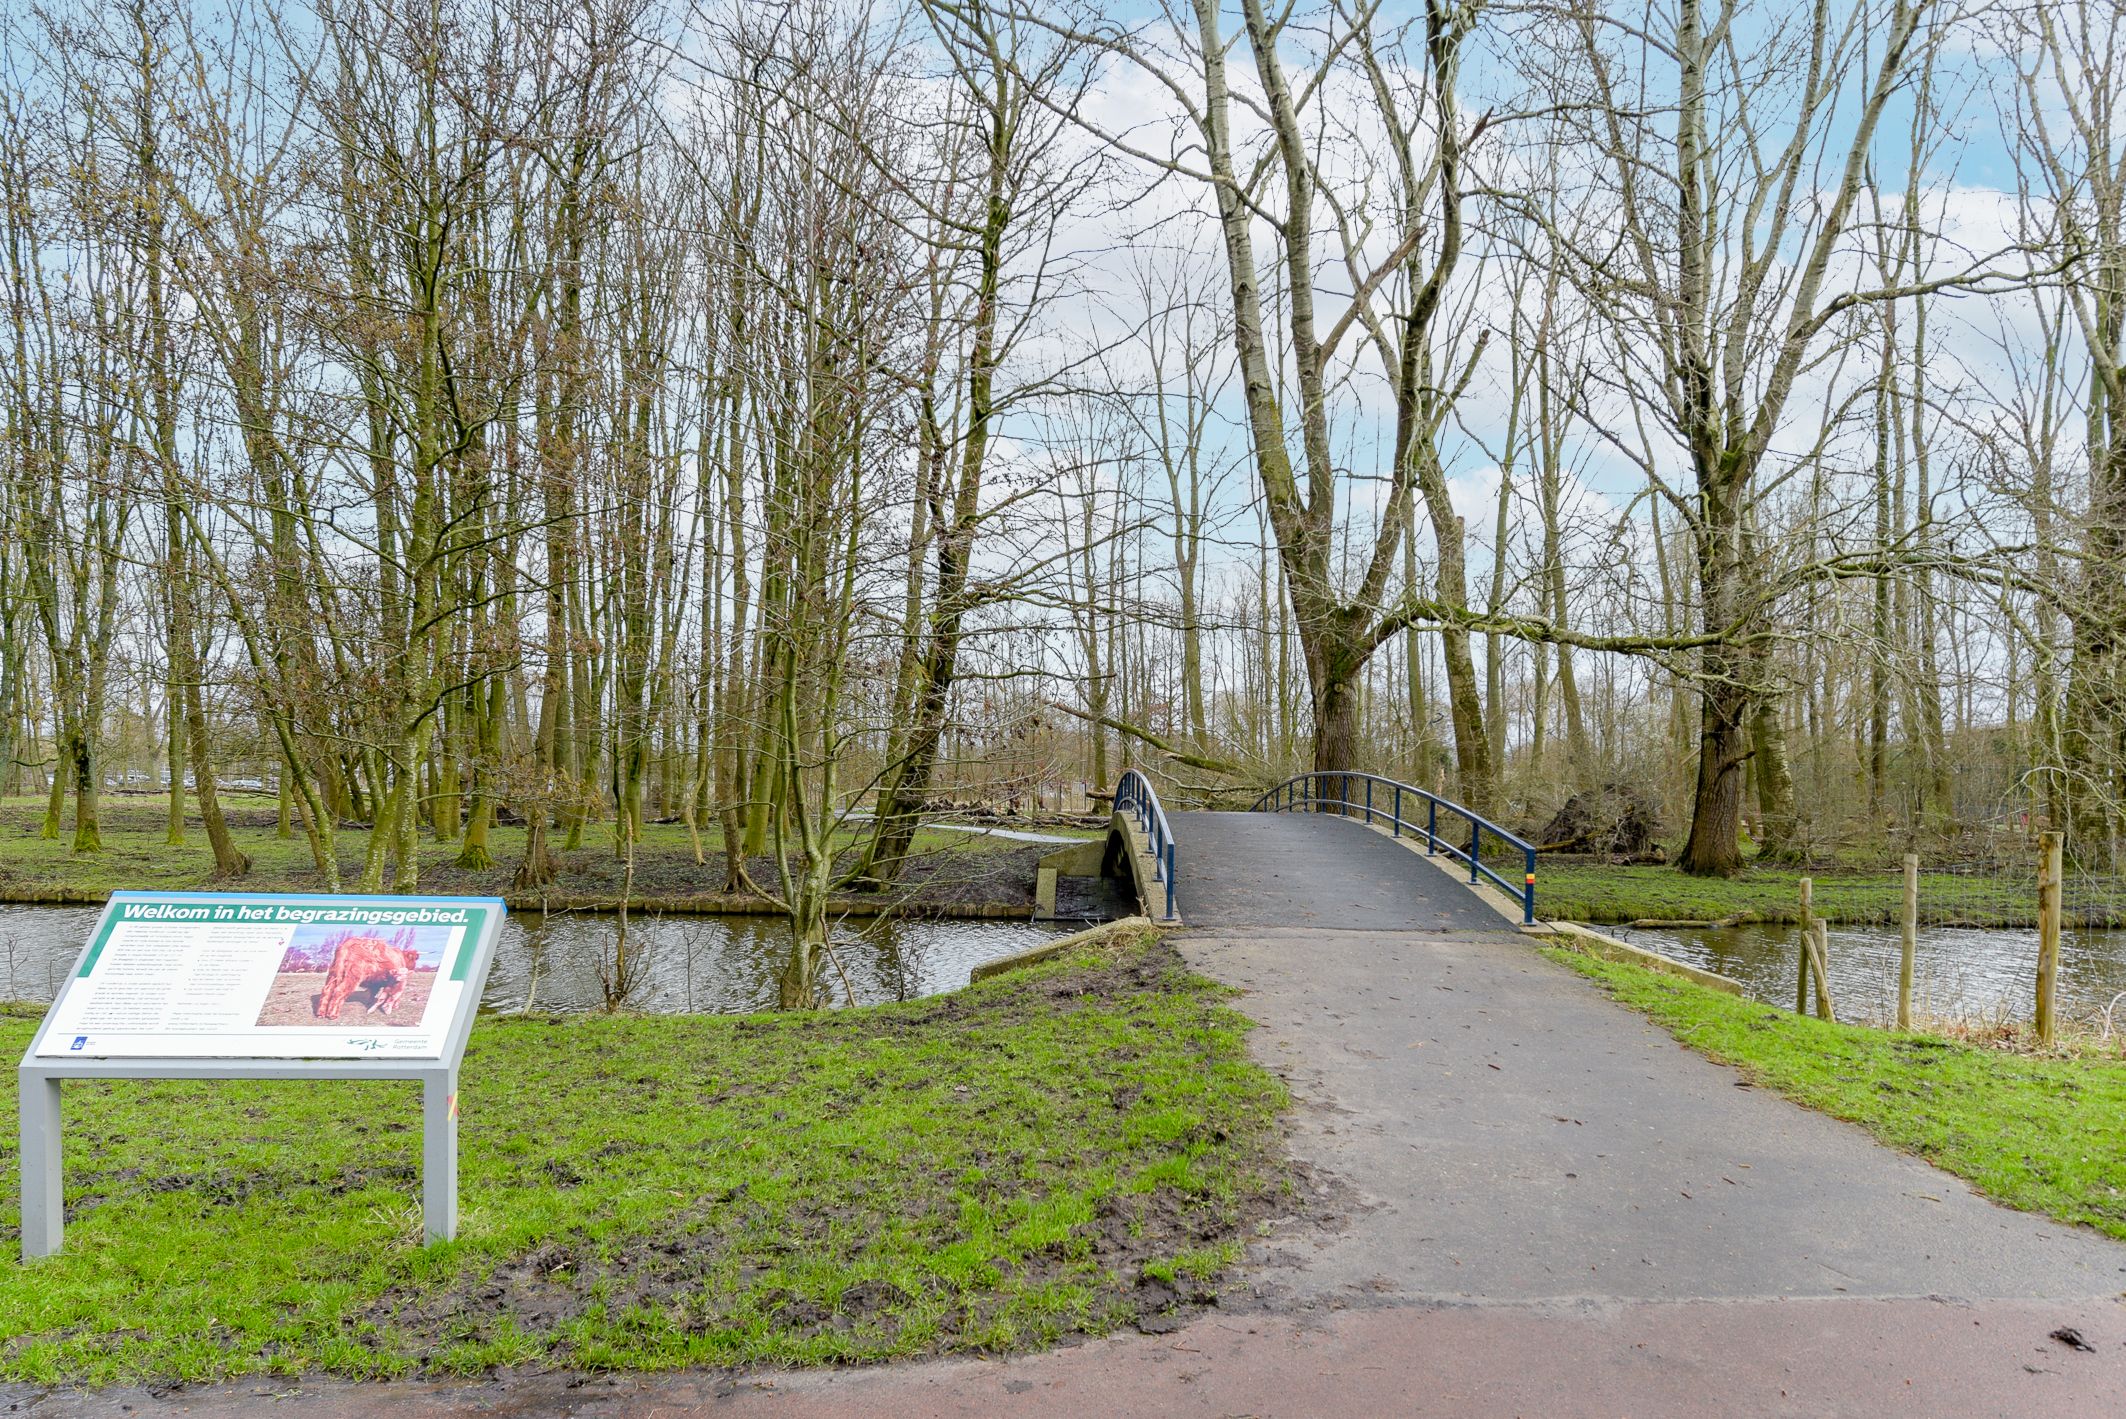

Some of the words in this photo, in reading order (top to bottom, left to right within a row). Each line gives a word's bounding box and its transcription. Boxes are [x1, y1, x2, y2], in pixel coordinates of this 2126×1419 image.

[124, 904, 210, 920] Welkom
[214, 905, 233, 921] in
[238, 905, 273, 921] het
[275, 906, 469, 925] begrazingsgebied.
